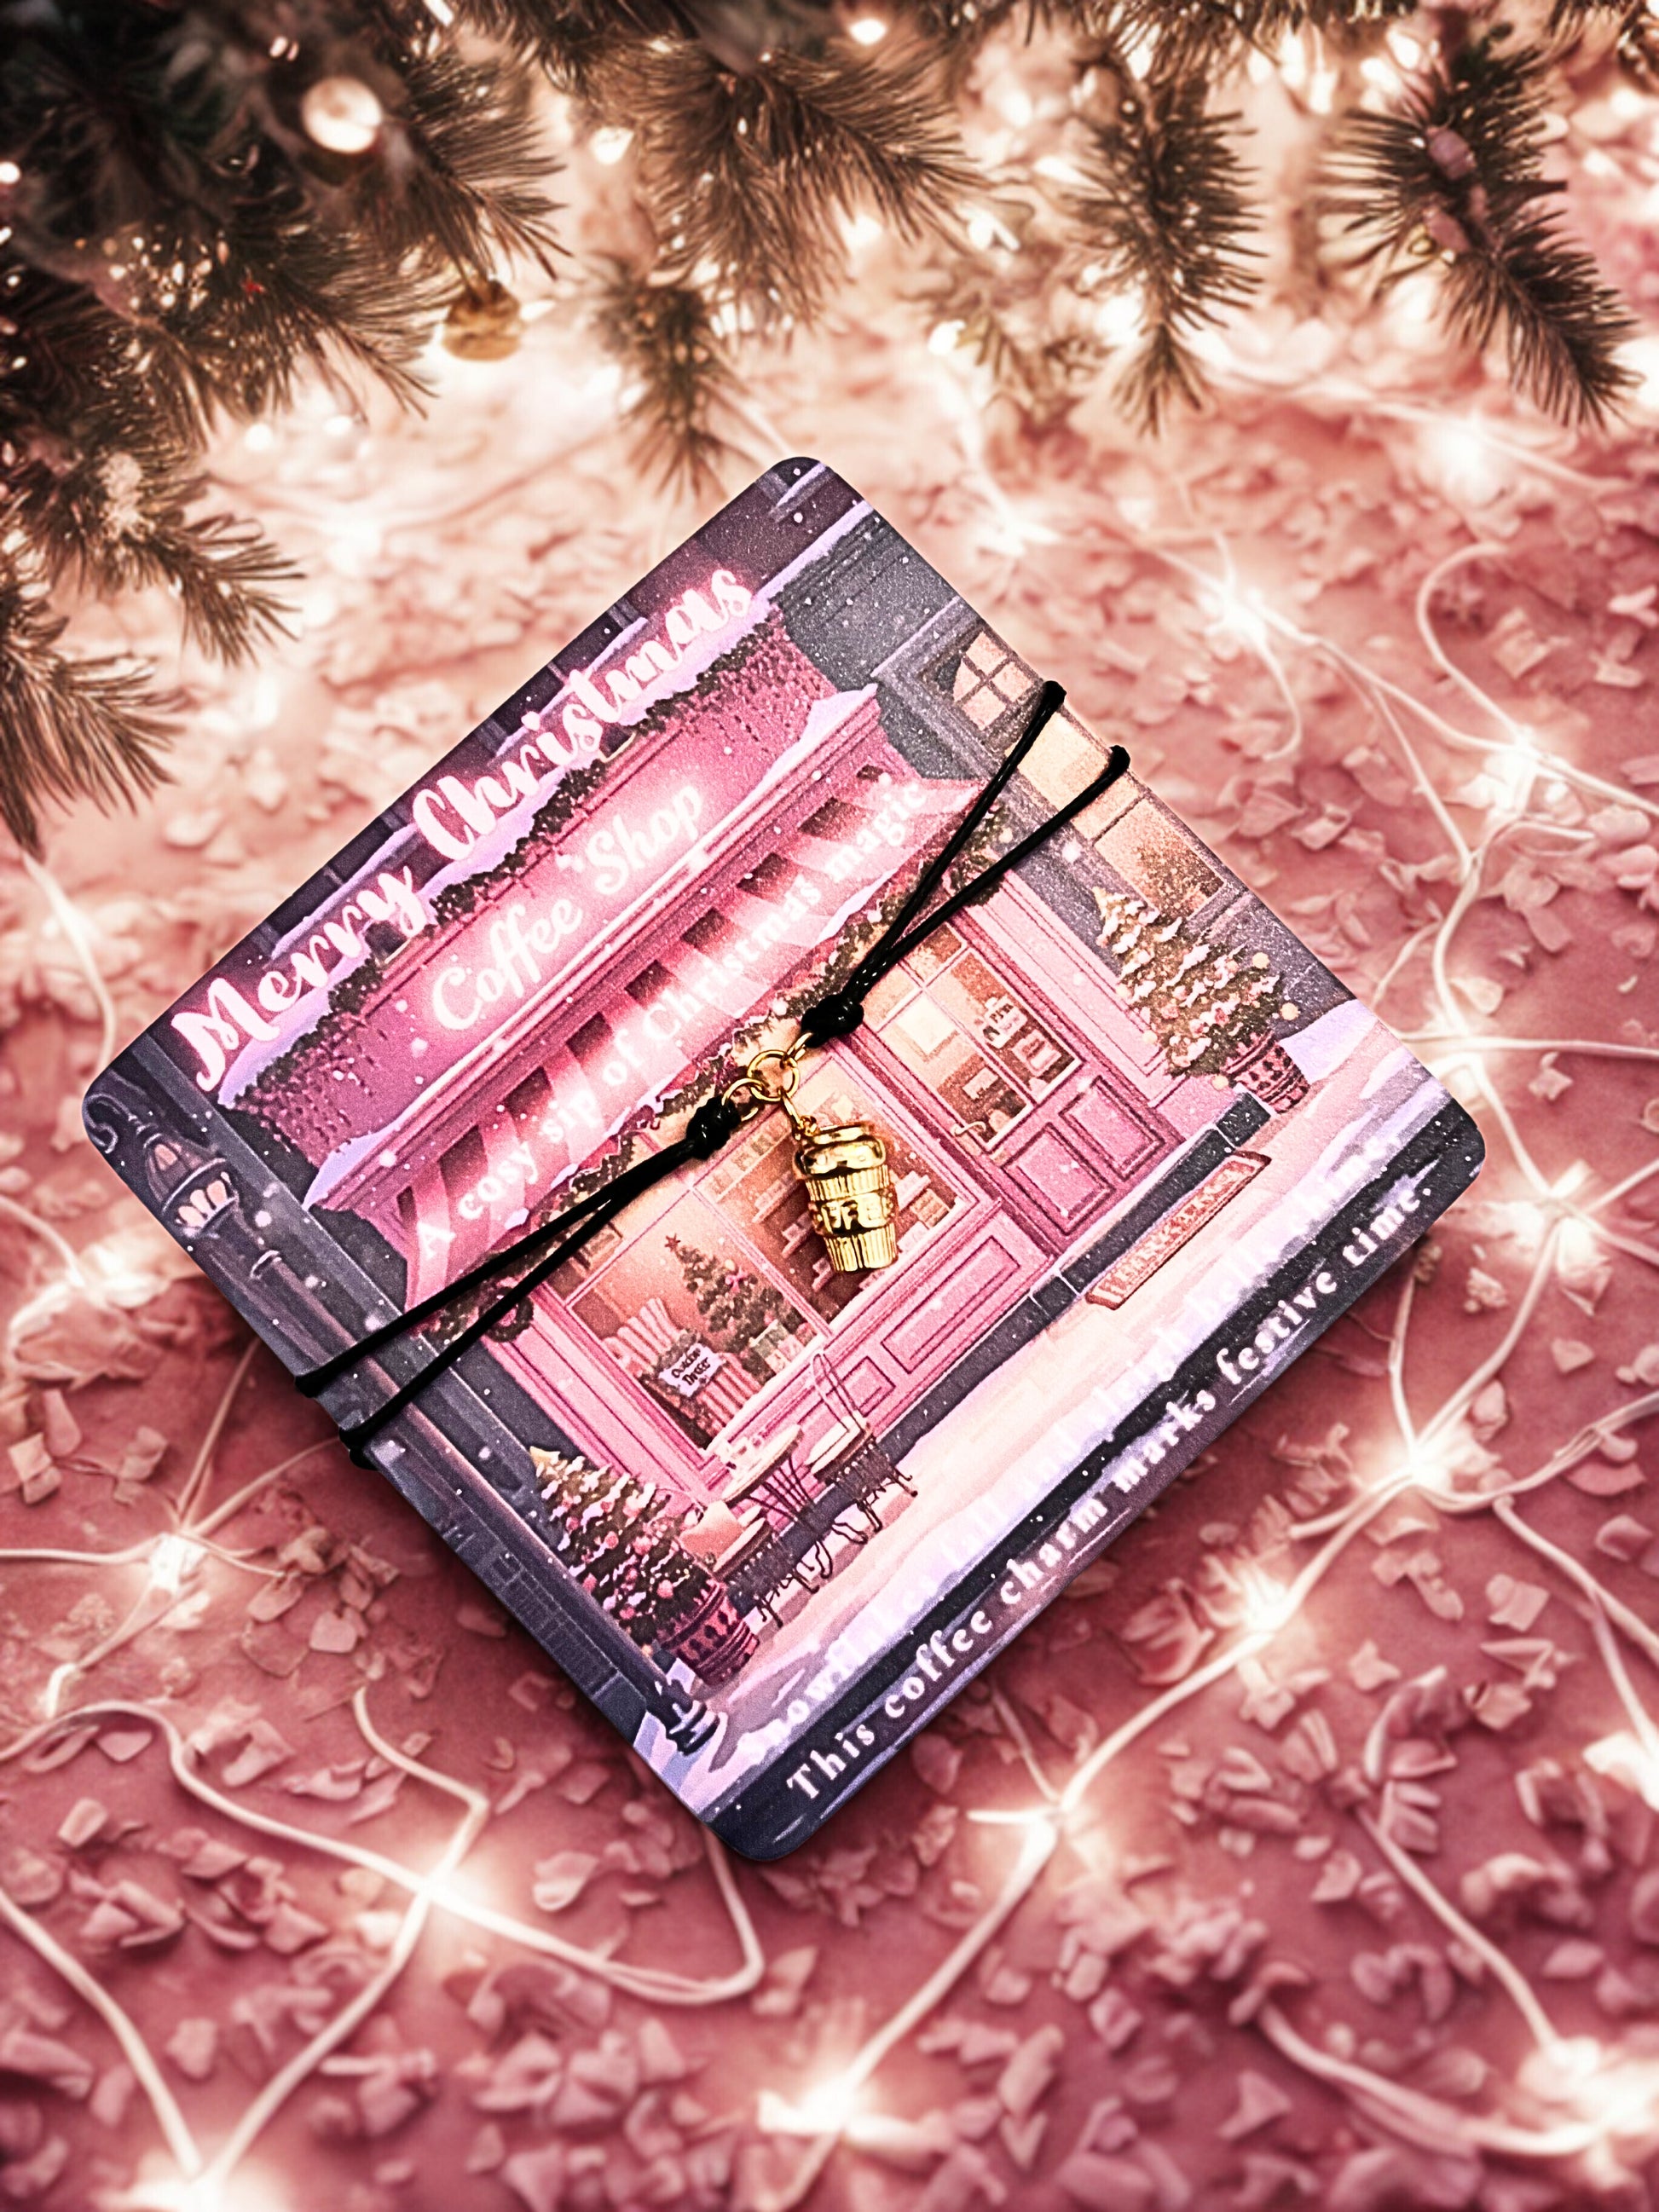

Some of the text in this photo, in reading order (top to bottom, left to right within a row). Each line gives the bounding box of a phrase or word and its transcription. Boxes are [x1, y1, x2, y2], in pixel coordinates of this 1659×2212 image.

[171, 569, 753, 1092] Merry Christmas
[416, 781, 928, 1261] A cosy sip of Christmas magic
[431, 785, 703, 1031] Coffee Shop
[786, 1724, 875, 1799] This
[884, 1610, 992, 1718] coffee
[999, 1497, 1108, 1605] charm
[1111, 1389, 1217, 1493] marks
[1216, 1272, 1338, 1385] festive
[1342, 1187, 1432, 1268] time.
[1184, 1245, 1280, 1322] bells
